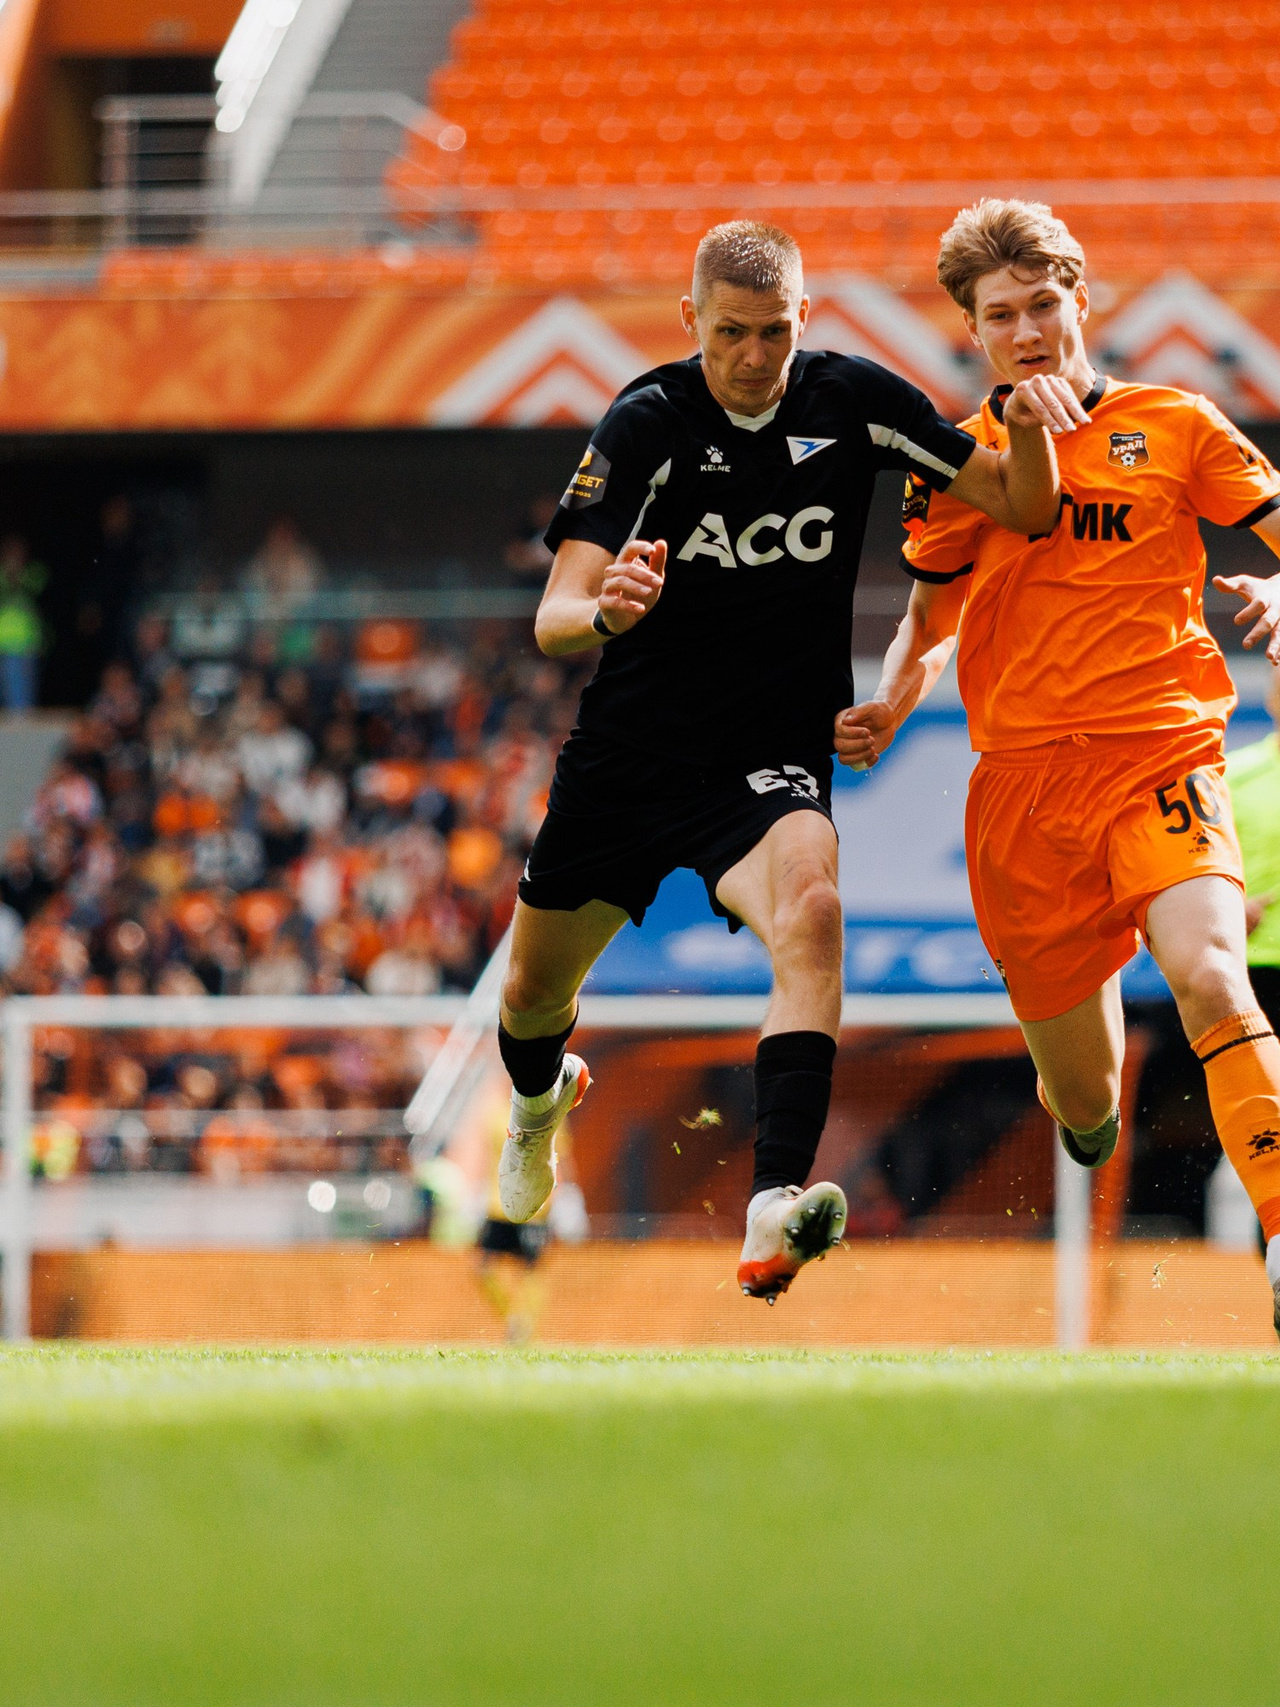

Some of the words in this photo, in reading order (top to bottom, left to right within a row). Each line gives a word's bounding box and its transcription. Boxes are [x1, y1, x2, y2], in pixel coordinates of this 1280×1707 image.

[1112, 440, 1143, 456] УРАЛ
[700, 464, 731, 473] KELME
[676, 505, 835, 568] ACG
[1155, 773, 1222, 835] 50
